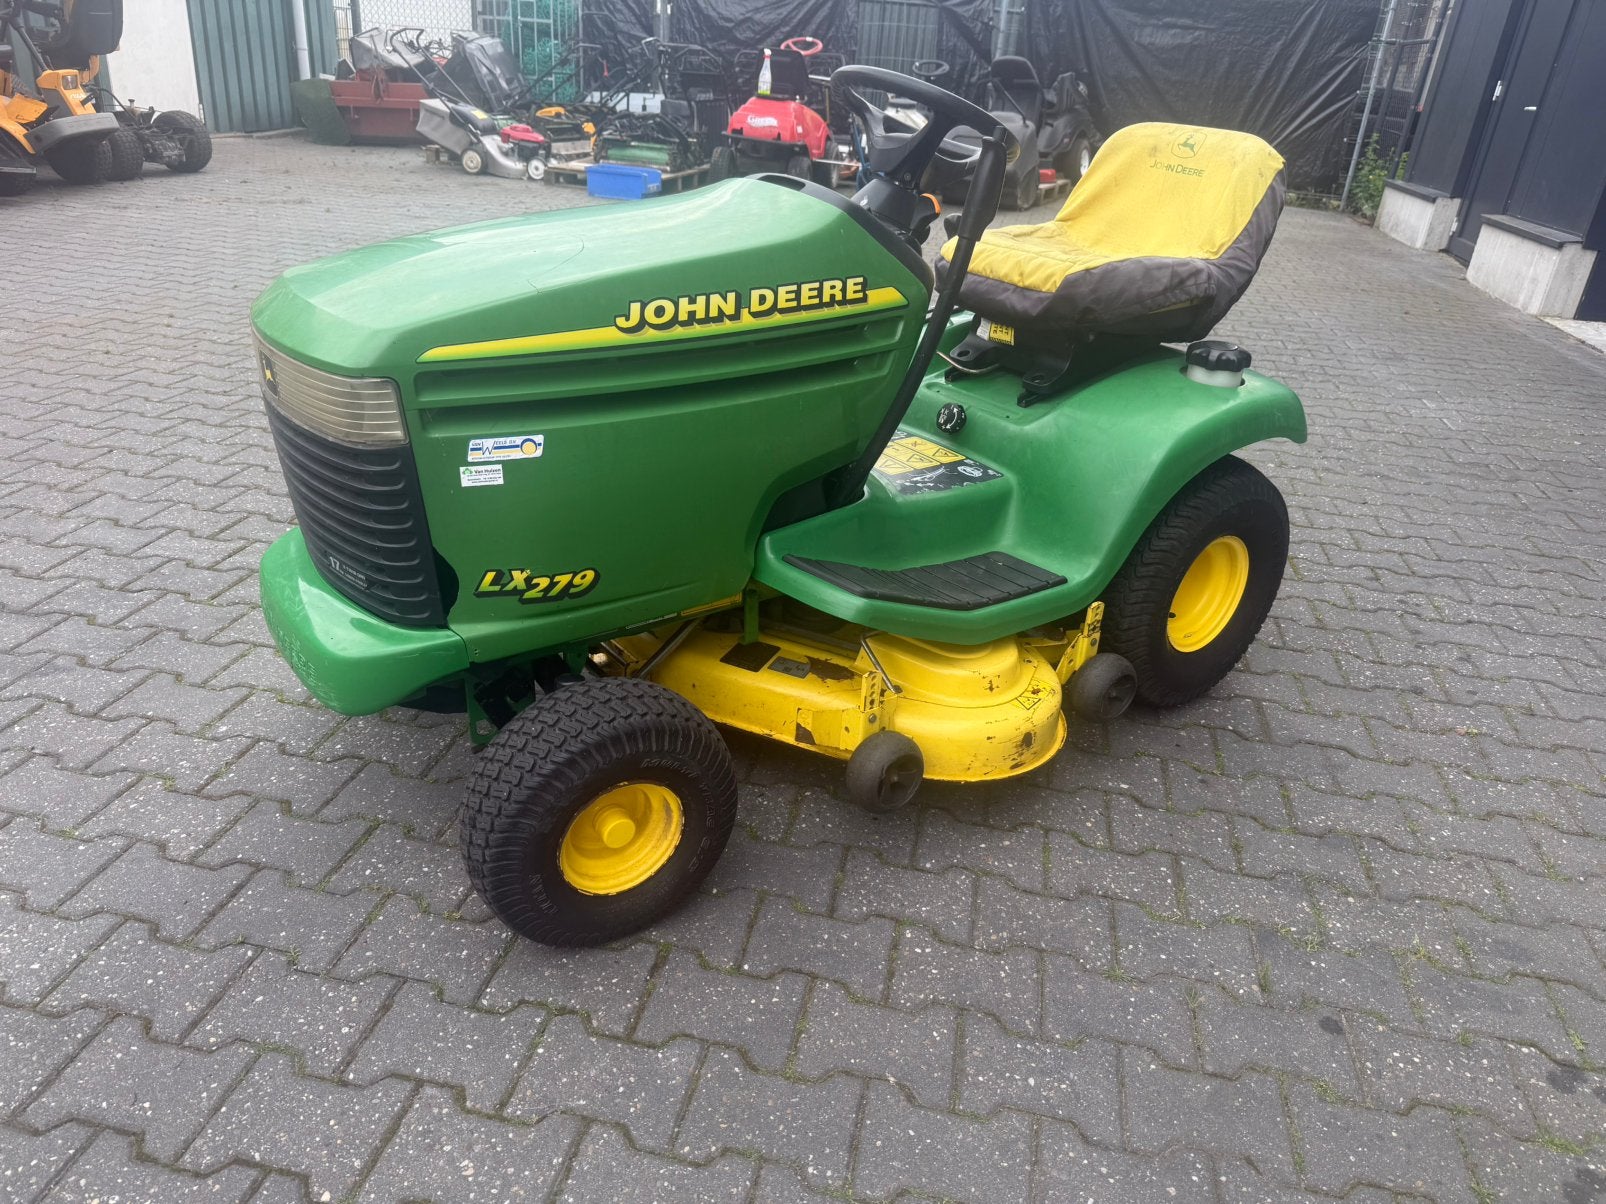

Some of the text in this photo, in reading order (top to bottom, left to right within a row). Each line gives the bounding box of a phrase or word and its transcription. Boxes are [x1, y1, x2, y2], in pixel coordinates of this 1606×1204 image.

[1149, 159, 1206, 178] JOHN DEERE
[614, 276, 867, 332] JOHN DEERE
